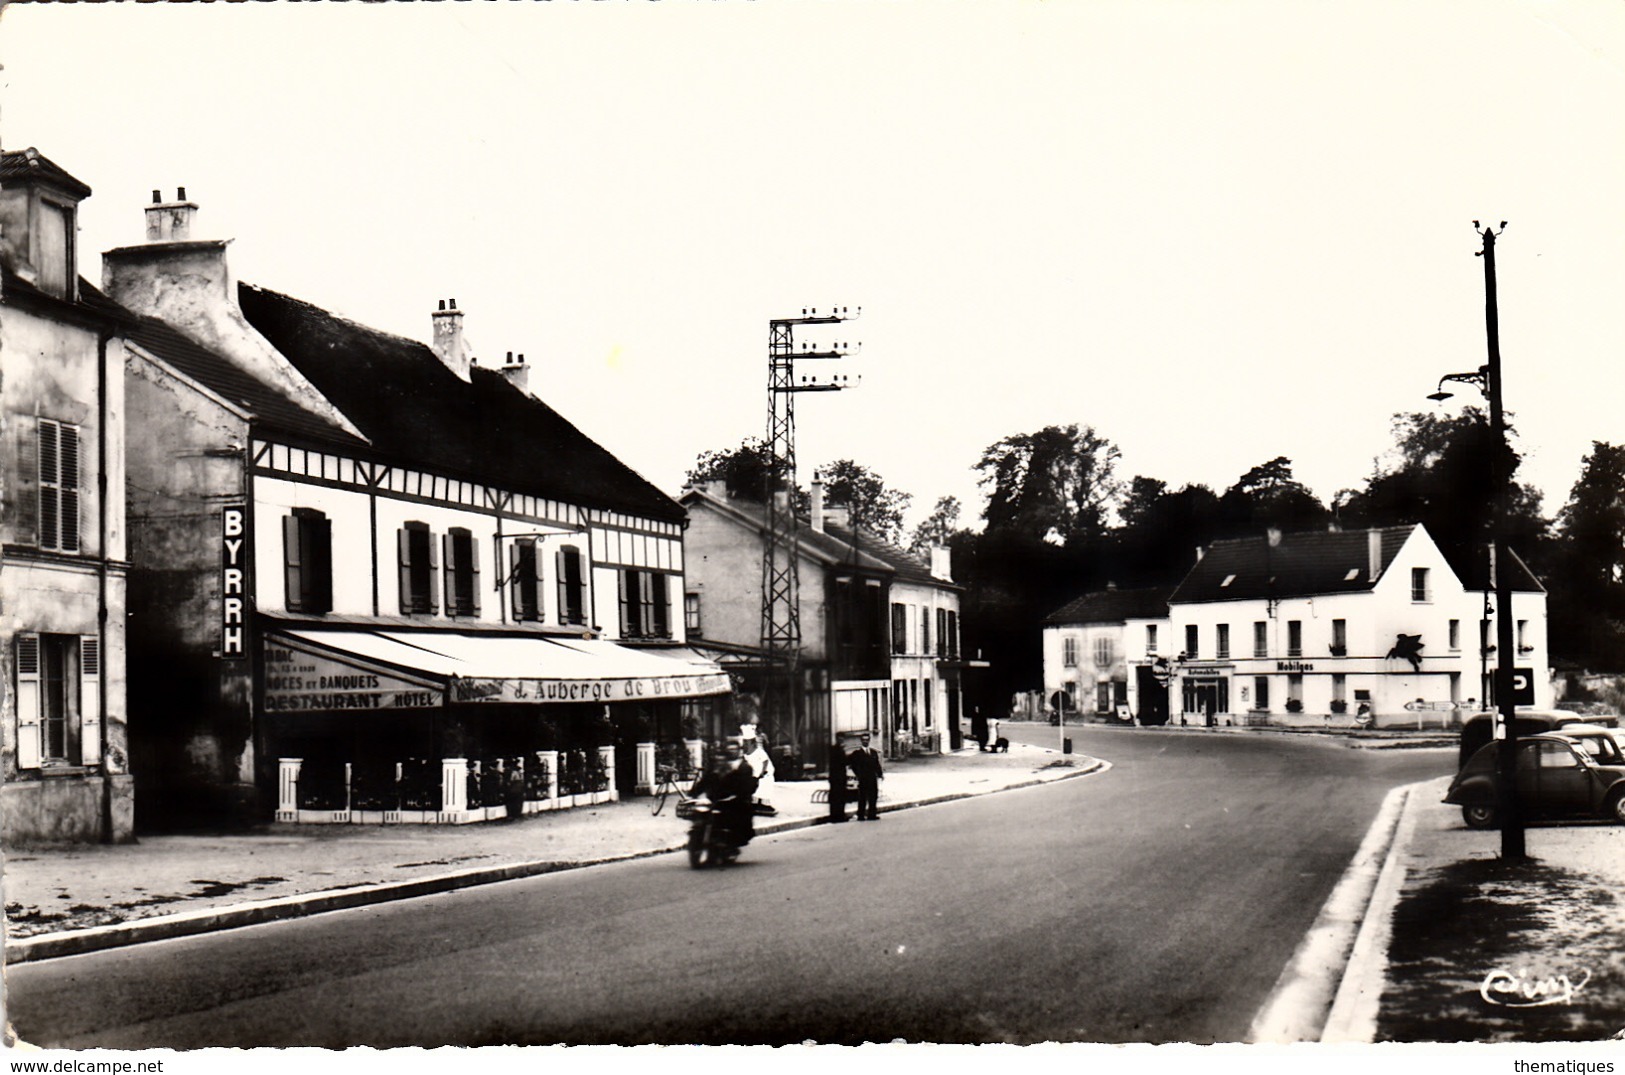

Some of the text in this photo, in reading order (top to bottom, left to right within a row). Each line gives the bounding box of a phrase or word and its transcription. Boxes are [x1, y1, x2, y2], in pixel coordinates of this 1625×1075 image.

[224, 510, 243, 653] BYRRH
[1277, 661, 1314, 674] Mobilgas
[267, 675, 380, 690] NOCES ET BANQUETS
[624, 680, 644, 697] de
[651, 679, 691, 695] Brou
[265, 694, 382, 710] RESTAURANT
